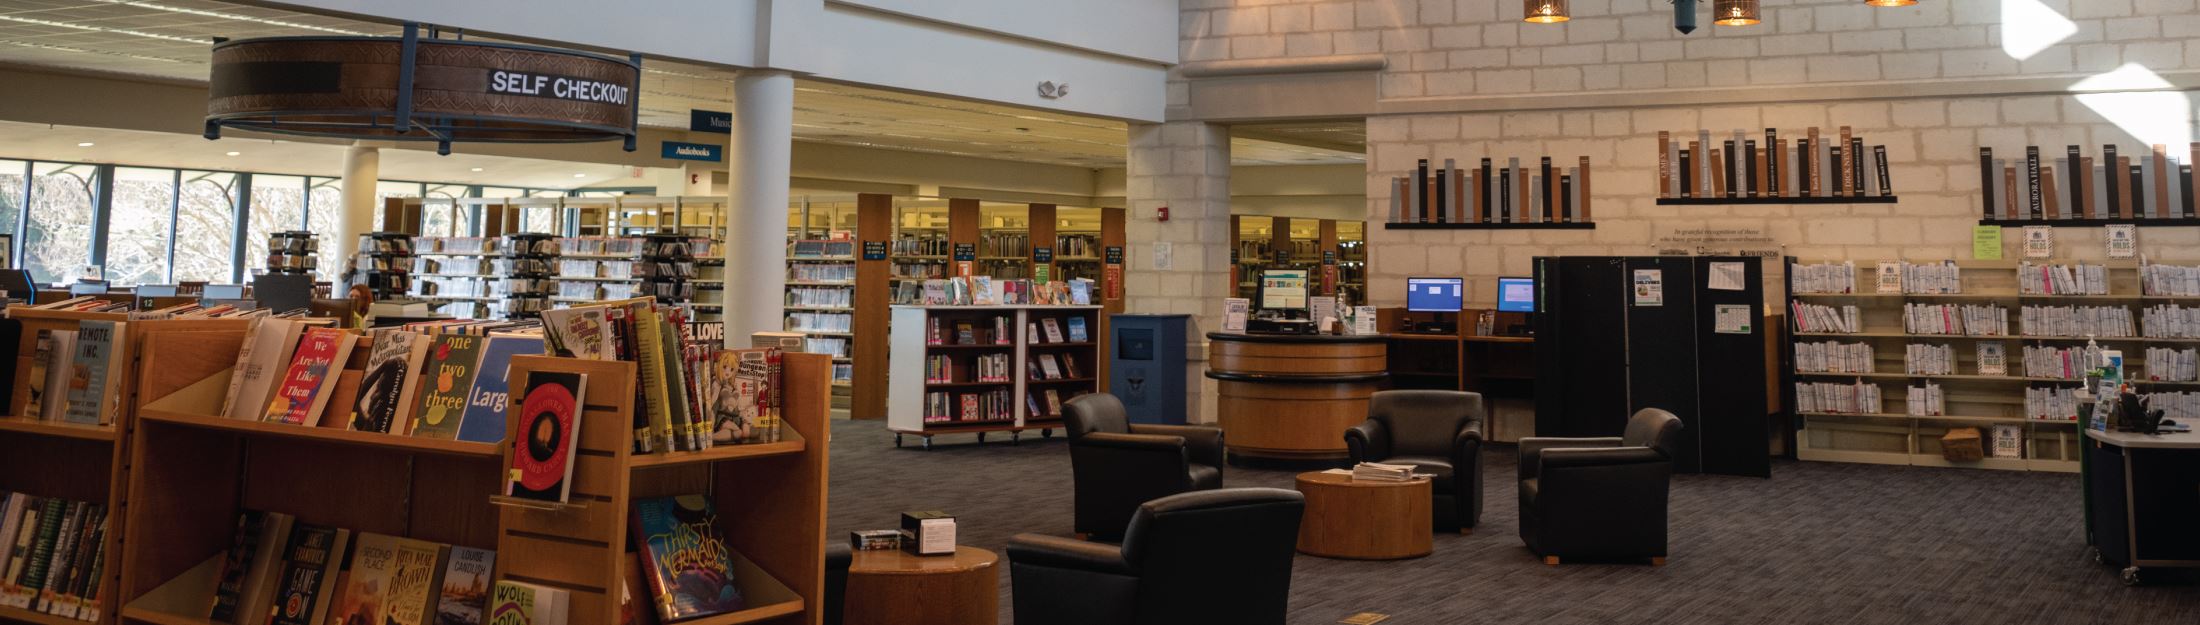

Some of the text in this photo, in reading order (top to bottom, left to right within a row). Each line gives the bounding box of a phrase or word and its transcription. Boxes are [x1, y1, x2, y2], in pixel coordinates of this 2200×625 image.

[492, 71, 628, 105] SELF CHECKOUT
[676, 146, 710, 157] Audiobooks
[2030, 157, 2040, 211] AURORA HALL
[144, 299, 153, 307] 12
[697, 323, 723, 340] LOVE
[313, 341, 327, 352] We
[374, 334, 405, 354] Dear Miss
[447, 336, 471, 350] one
[297, 356, 329, 366] Are Not
[738, 360, 767, 372] Dungeon
[296, 371, 315, 382] Like
[440, 362, 465, 378] two
[286, 386, 310, 398] Them
[425, 389, 463, 410] three
[647, 514, 717, 554] THIRSTY
[395, 549, 433, 568] RITA MAE
[462, 550, 484, 561] LOUISE
[659, 538, 728, 578] MERMAIDS
[363, 558, 385, 570] PLACE
[454, 561, 486, 575] CANDLISH
[290, 567, 318, 594] GAME
[388, 567, 430, 596] BROWN
[497, 585, 526, 607] WOLE
